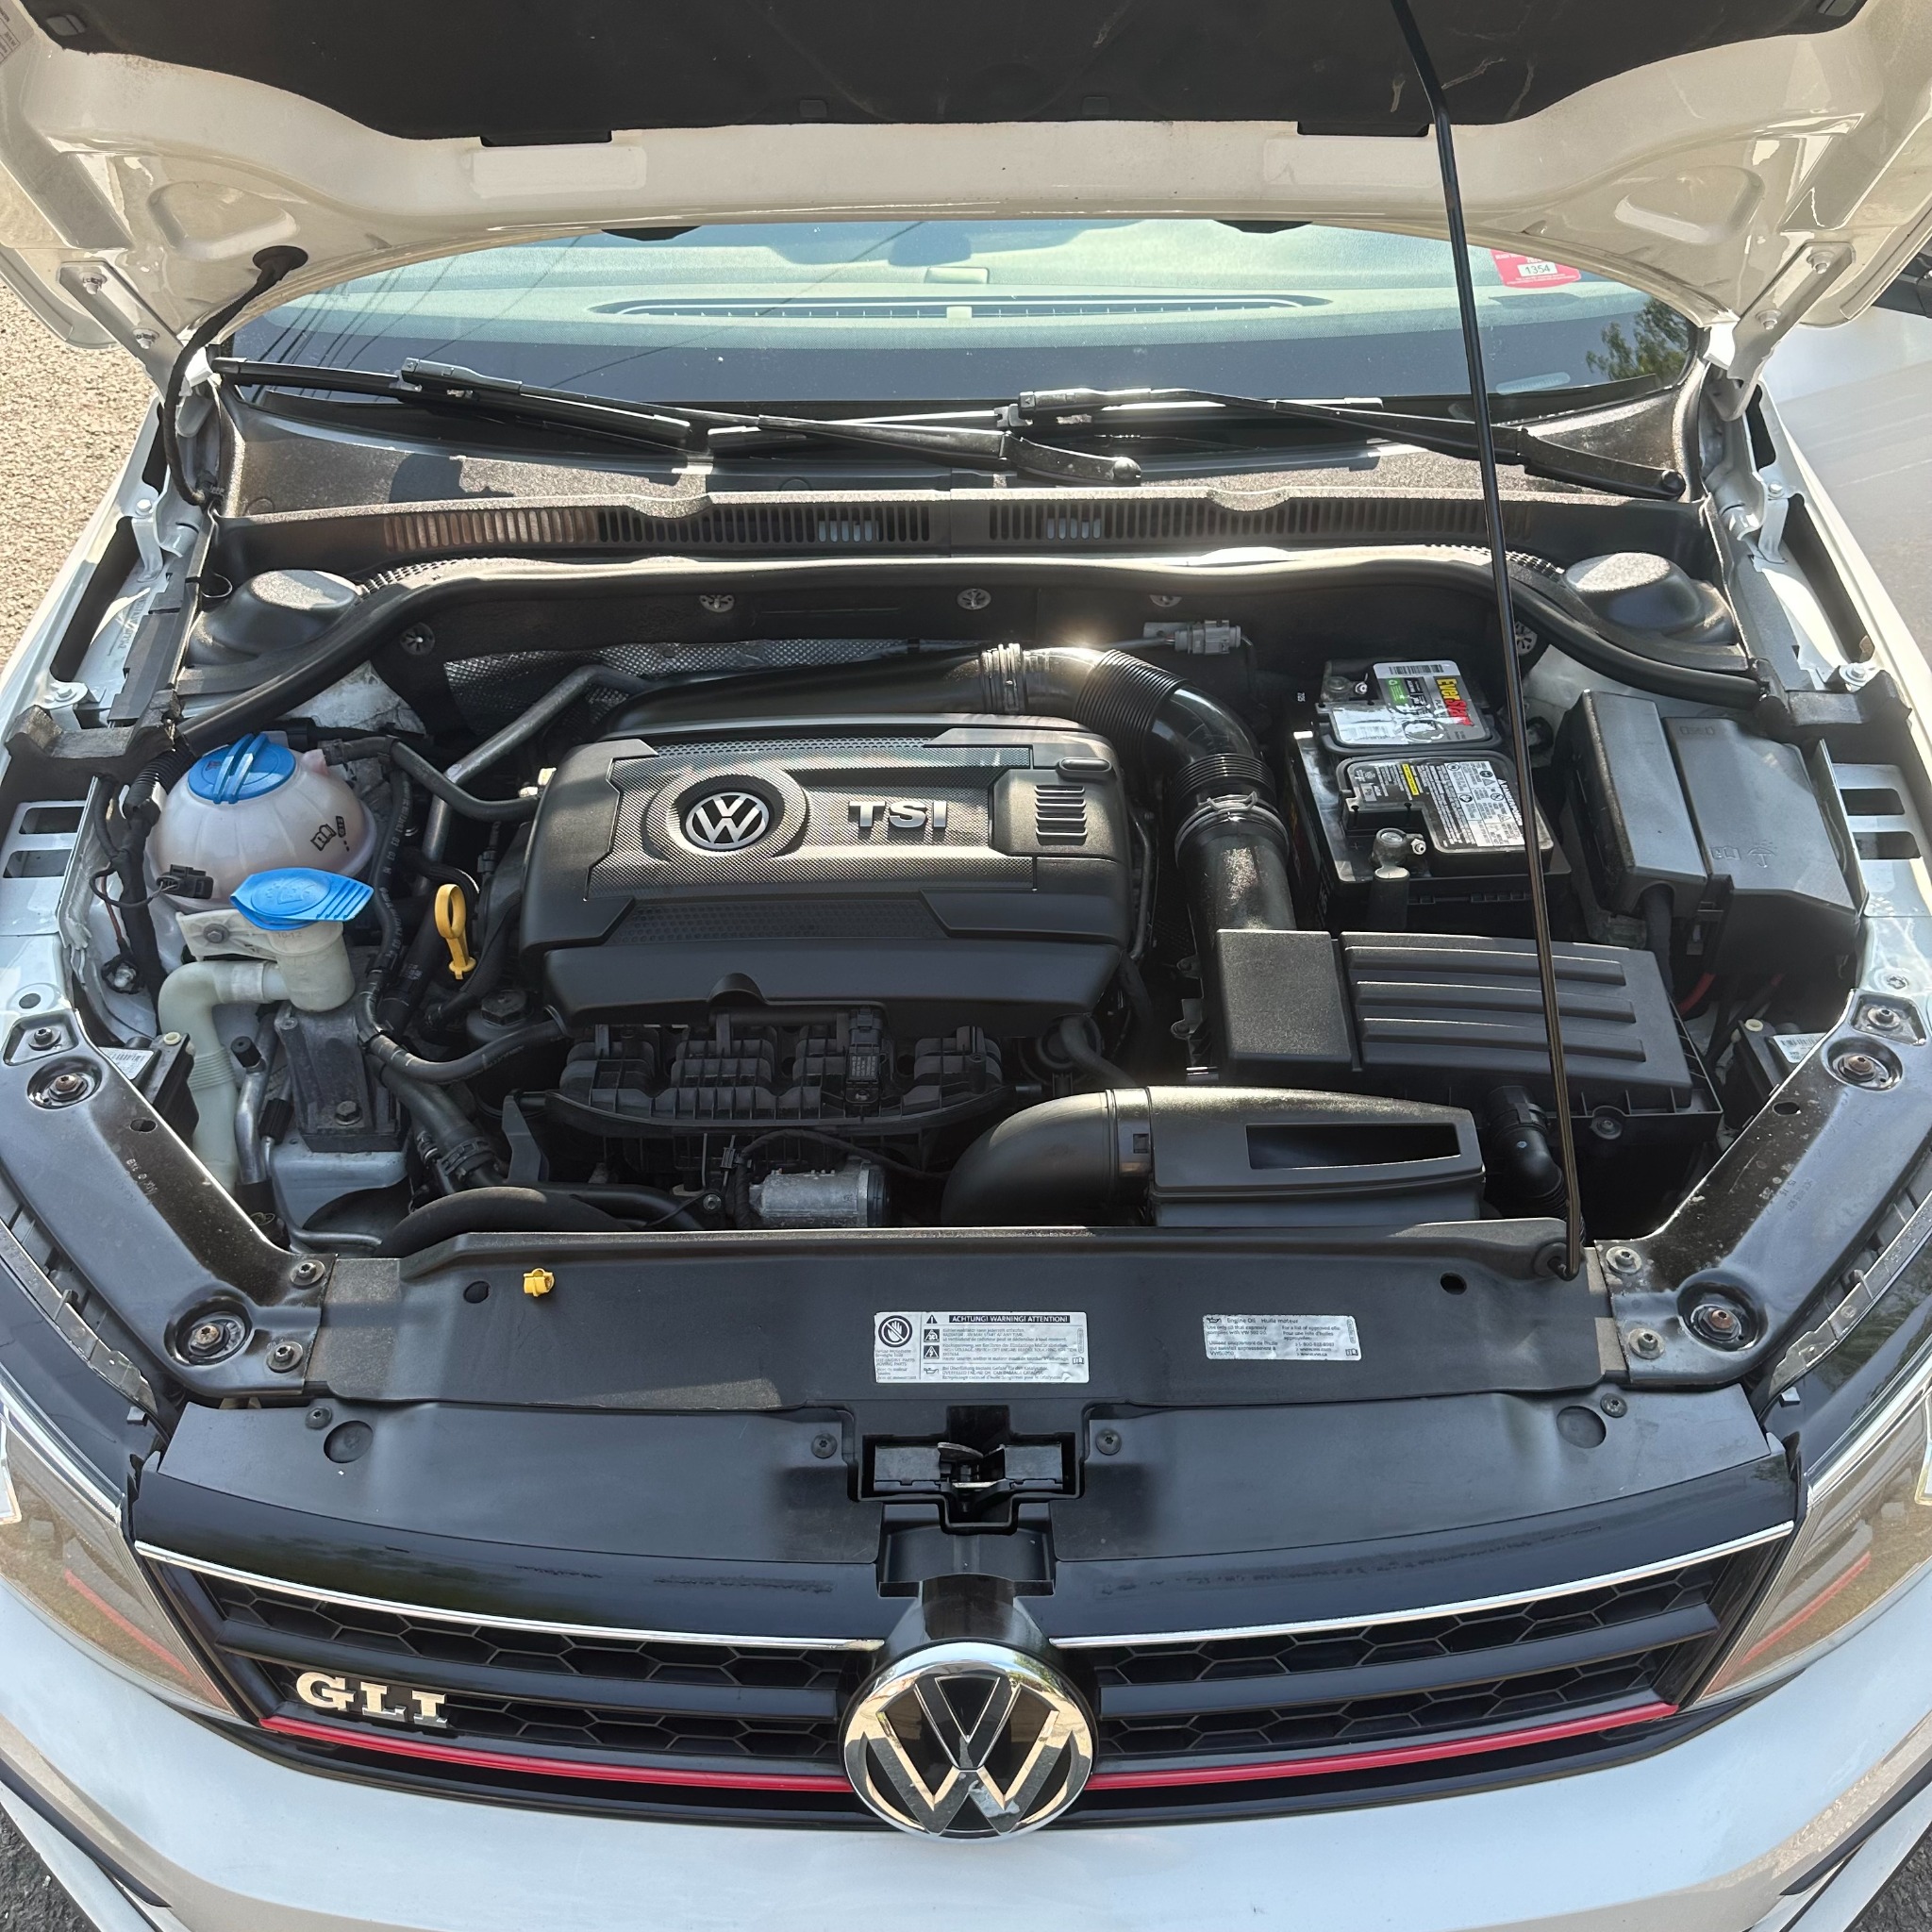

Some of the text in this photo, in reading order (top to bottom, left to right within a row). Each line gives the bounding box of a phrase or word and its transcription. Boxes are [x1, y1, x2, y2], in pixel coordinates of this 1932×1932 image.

[1524, 264, 1551, 275] 1354
[685, 791, 770, 849] VW
[849, 802, 948, 828] TSI
[296, 1672, 448, 1728] GLI
[844, 1641, 1093, 1843] VW
